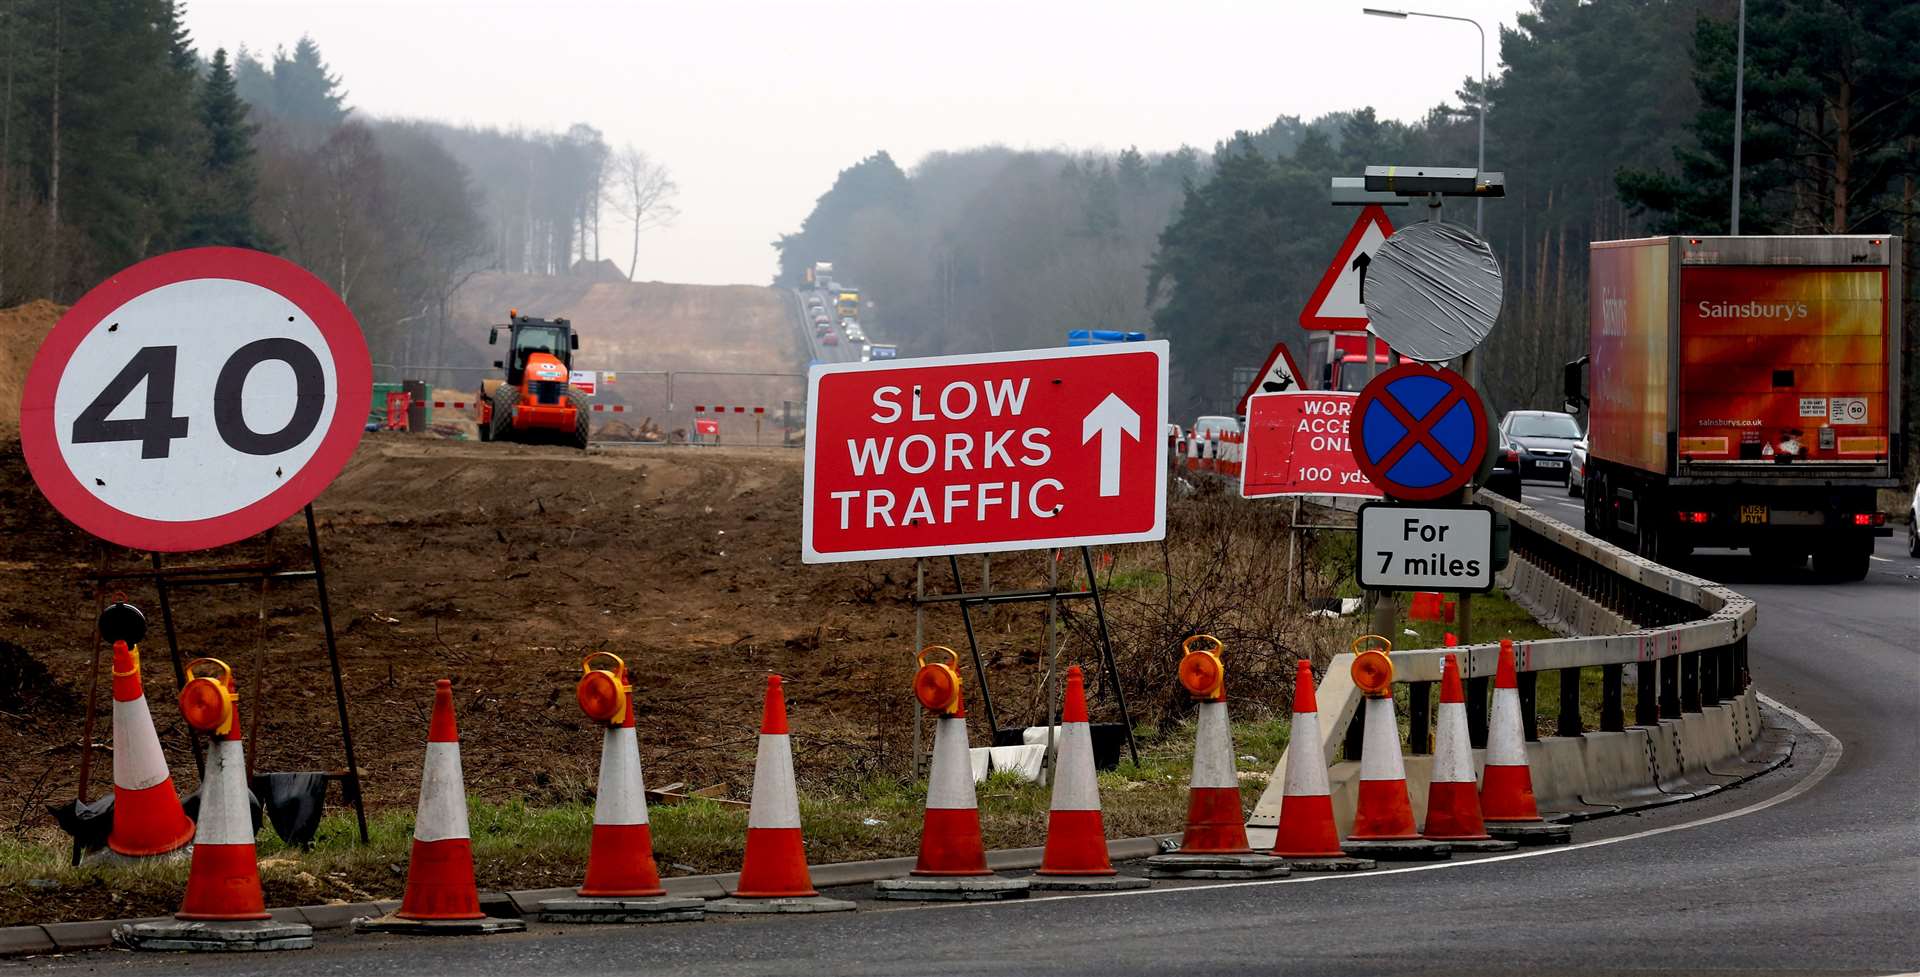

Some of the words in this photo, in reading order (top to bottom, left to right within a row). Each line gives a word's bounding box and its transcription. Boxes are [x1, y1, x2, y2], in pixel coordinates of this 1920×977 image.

[1699, 301, 1808, 321] Sainsbury's
[71, 337, 325, 459] 40
[870, 378, 1031, 424] SLOW
[1304, 401, 1352, 416] WOR
[1297, 418, 1351, 434] ACCE
[1698, 418, 1762, 427] sainsburys.co.uk
[847, 427, 1052, 476] WORKS
[1310, 436, 1353, 452] ONL
[1299, 467, 1332, 481] 100
[830, 477, 1065, 530] TRAFFIC
[1403, 518, 1449, 542] For
[1376, 551, 1393, 574] 7
[1404, 552, 1480, 577] miles
